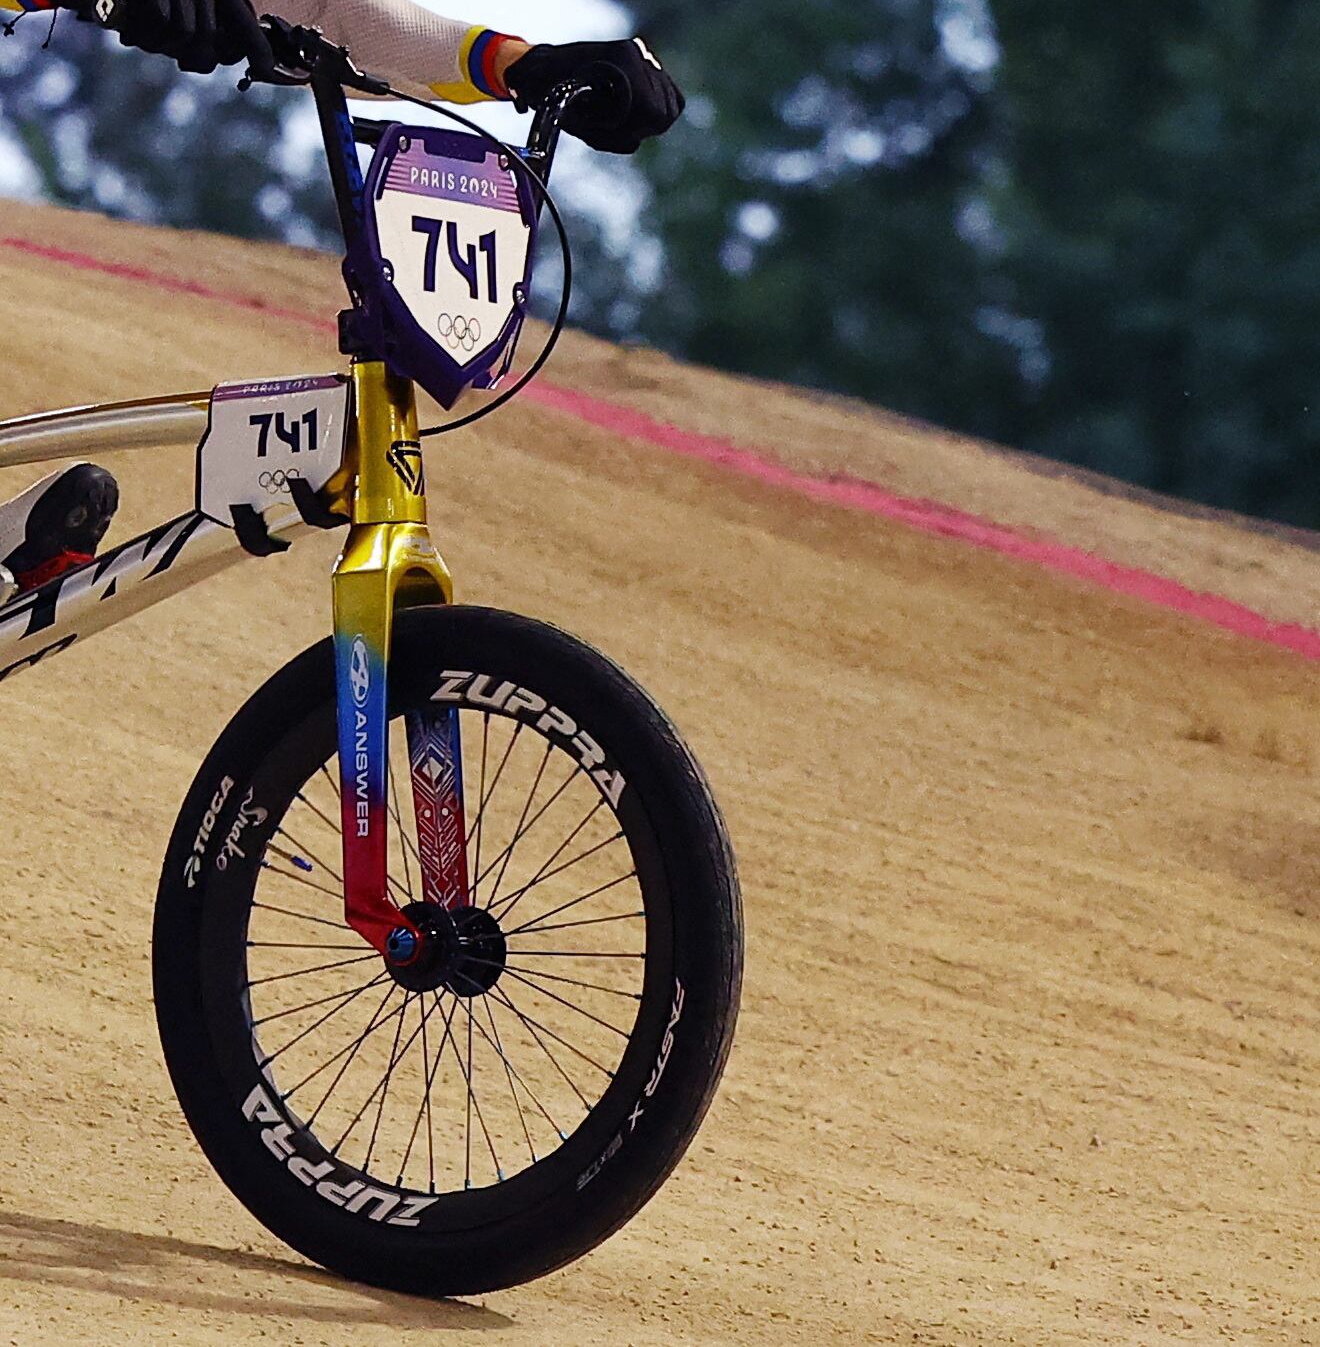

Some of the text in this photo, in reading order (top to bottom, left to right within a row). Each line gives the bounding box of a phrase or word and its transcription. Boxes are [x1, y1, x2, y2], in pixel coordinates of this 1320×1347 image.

[410, 166, 499, 199] PARIS 2024
[411, 214, 498, 304] 741
[248, 407, 318, 458] 741
[354, 709, 370, 838] ANSWER
[429, 669, 627, 810] ZUPPRA
[193, 775, 235, 855] TIOGA
[241, 1083, 441, 1228] ZUPPRA
